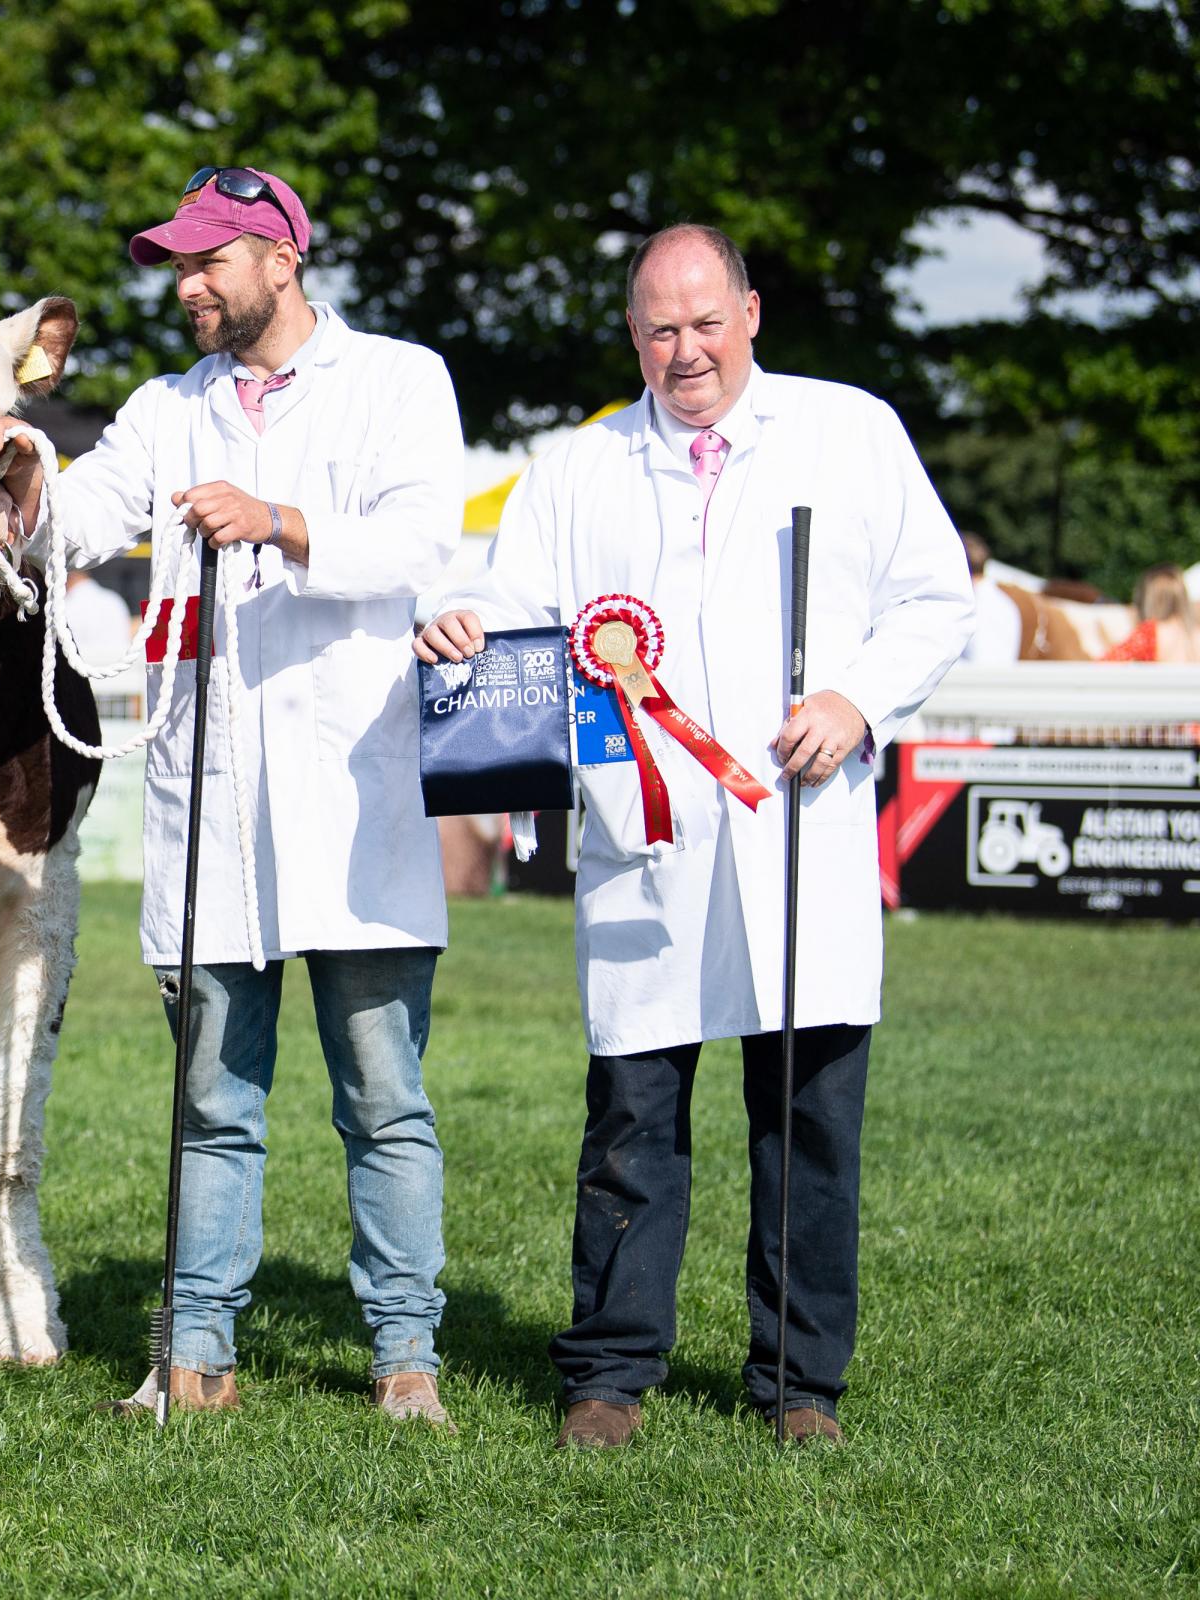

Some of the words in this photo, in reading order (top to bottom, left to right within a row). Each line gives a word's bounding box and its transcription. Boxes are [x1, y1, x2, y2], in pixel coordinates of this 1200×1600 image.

[477, 654, 514, 665] HIGHLAND
[478, 648, 497, 659] ROYAL
[523, 651, 555, 668] 200
[476, 662, 499, 673] SHOW
[499, 661, 518, 670] 2022
[523, 666, 556, 677] YEARS
[434, 684, 559, 714] CHAMPION
[604, 736, 626, 747] 200
[723, 757, 749, 783] Show
[1073, 836, 1200, 870] ENGINEERING
